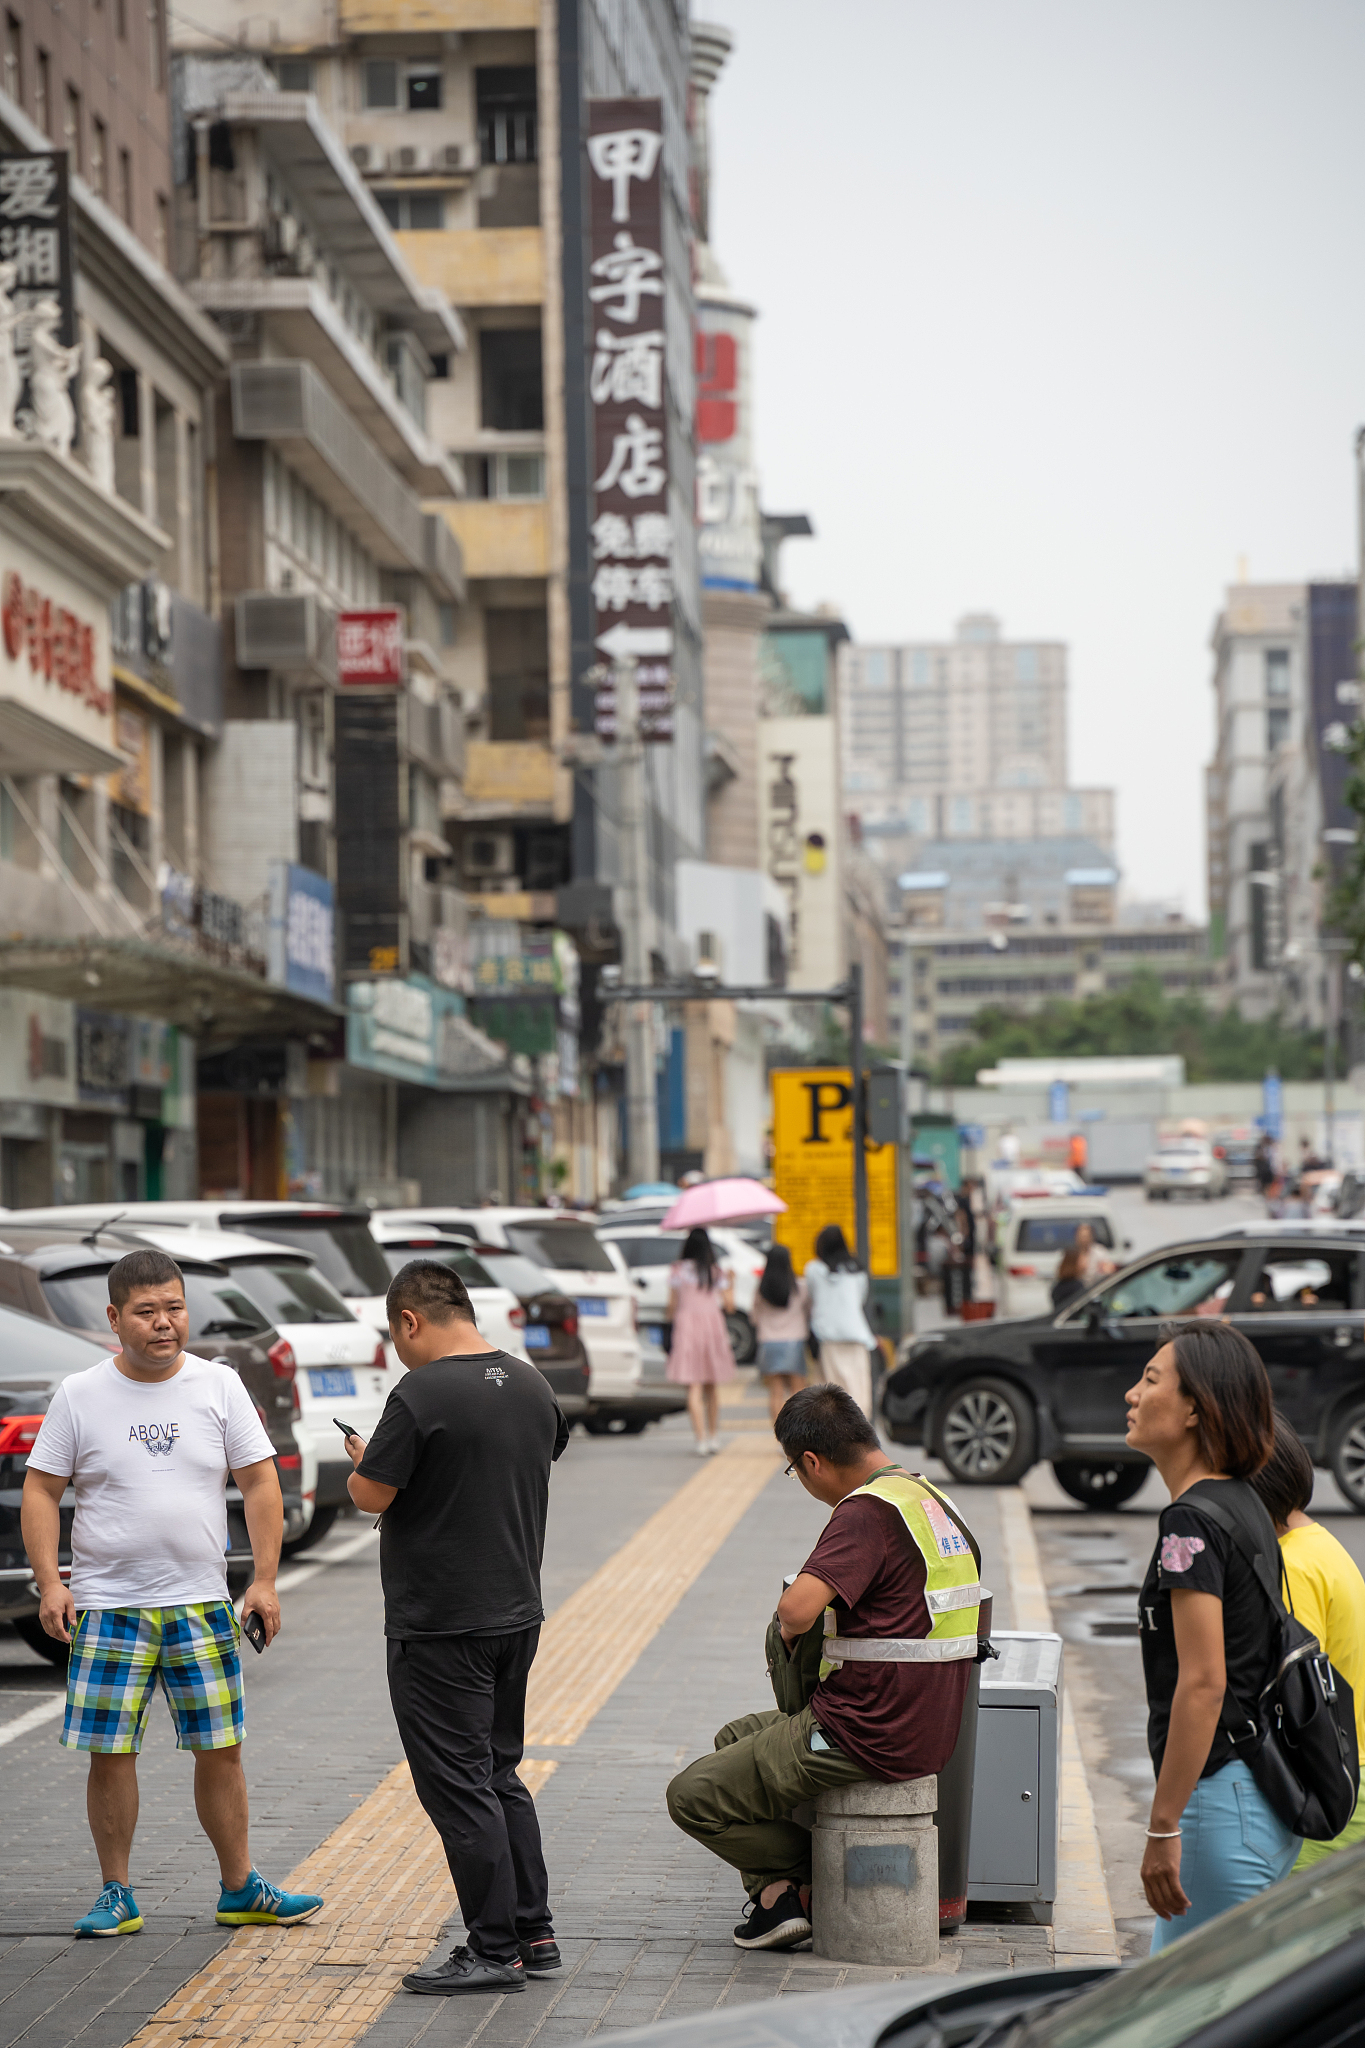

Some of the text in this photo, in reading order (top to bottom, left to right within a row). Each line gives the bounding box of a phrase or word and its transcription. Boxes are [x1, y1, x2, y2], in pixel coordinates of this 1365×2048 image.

[587, 128, 665, 498] 甲字酒店
[802, 1082, 853, 1143] P
[128, 1422, 181, 1442] ABOVE
